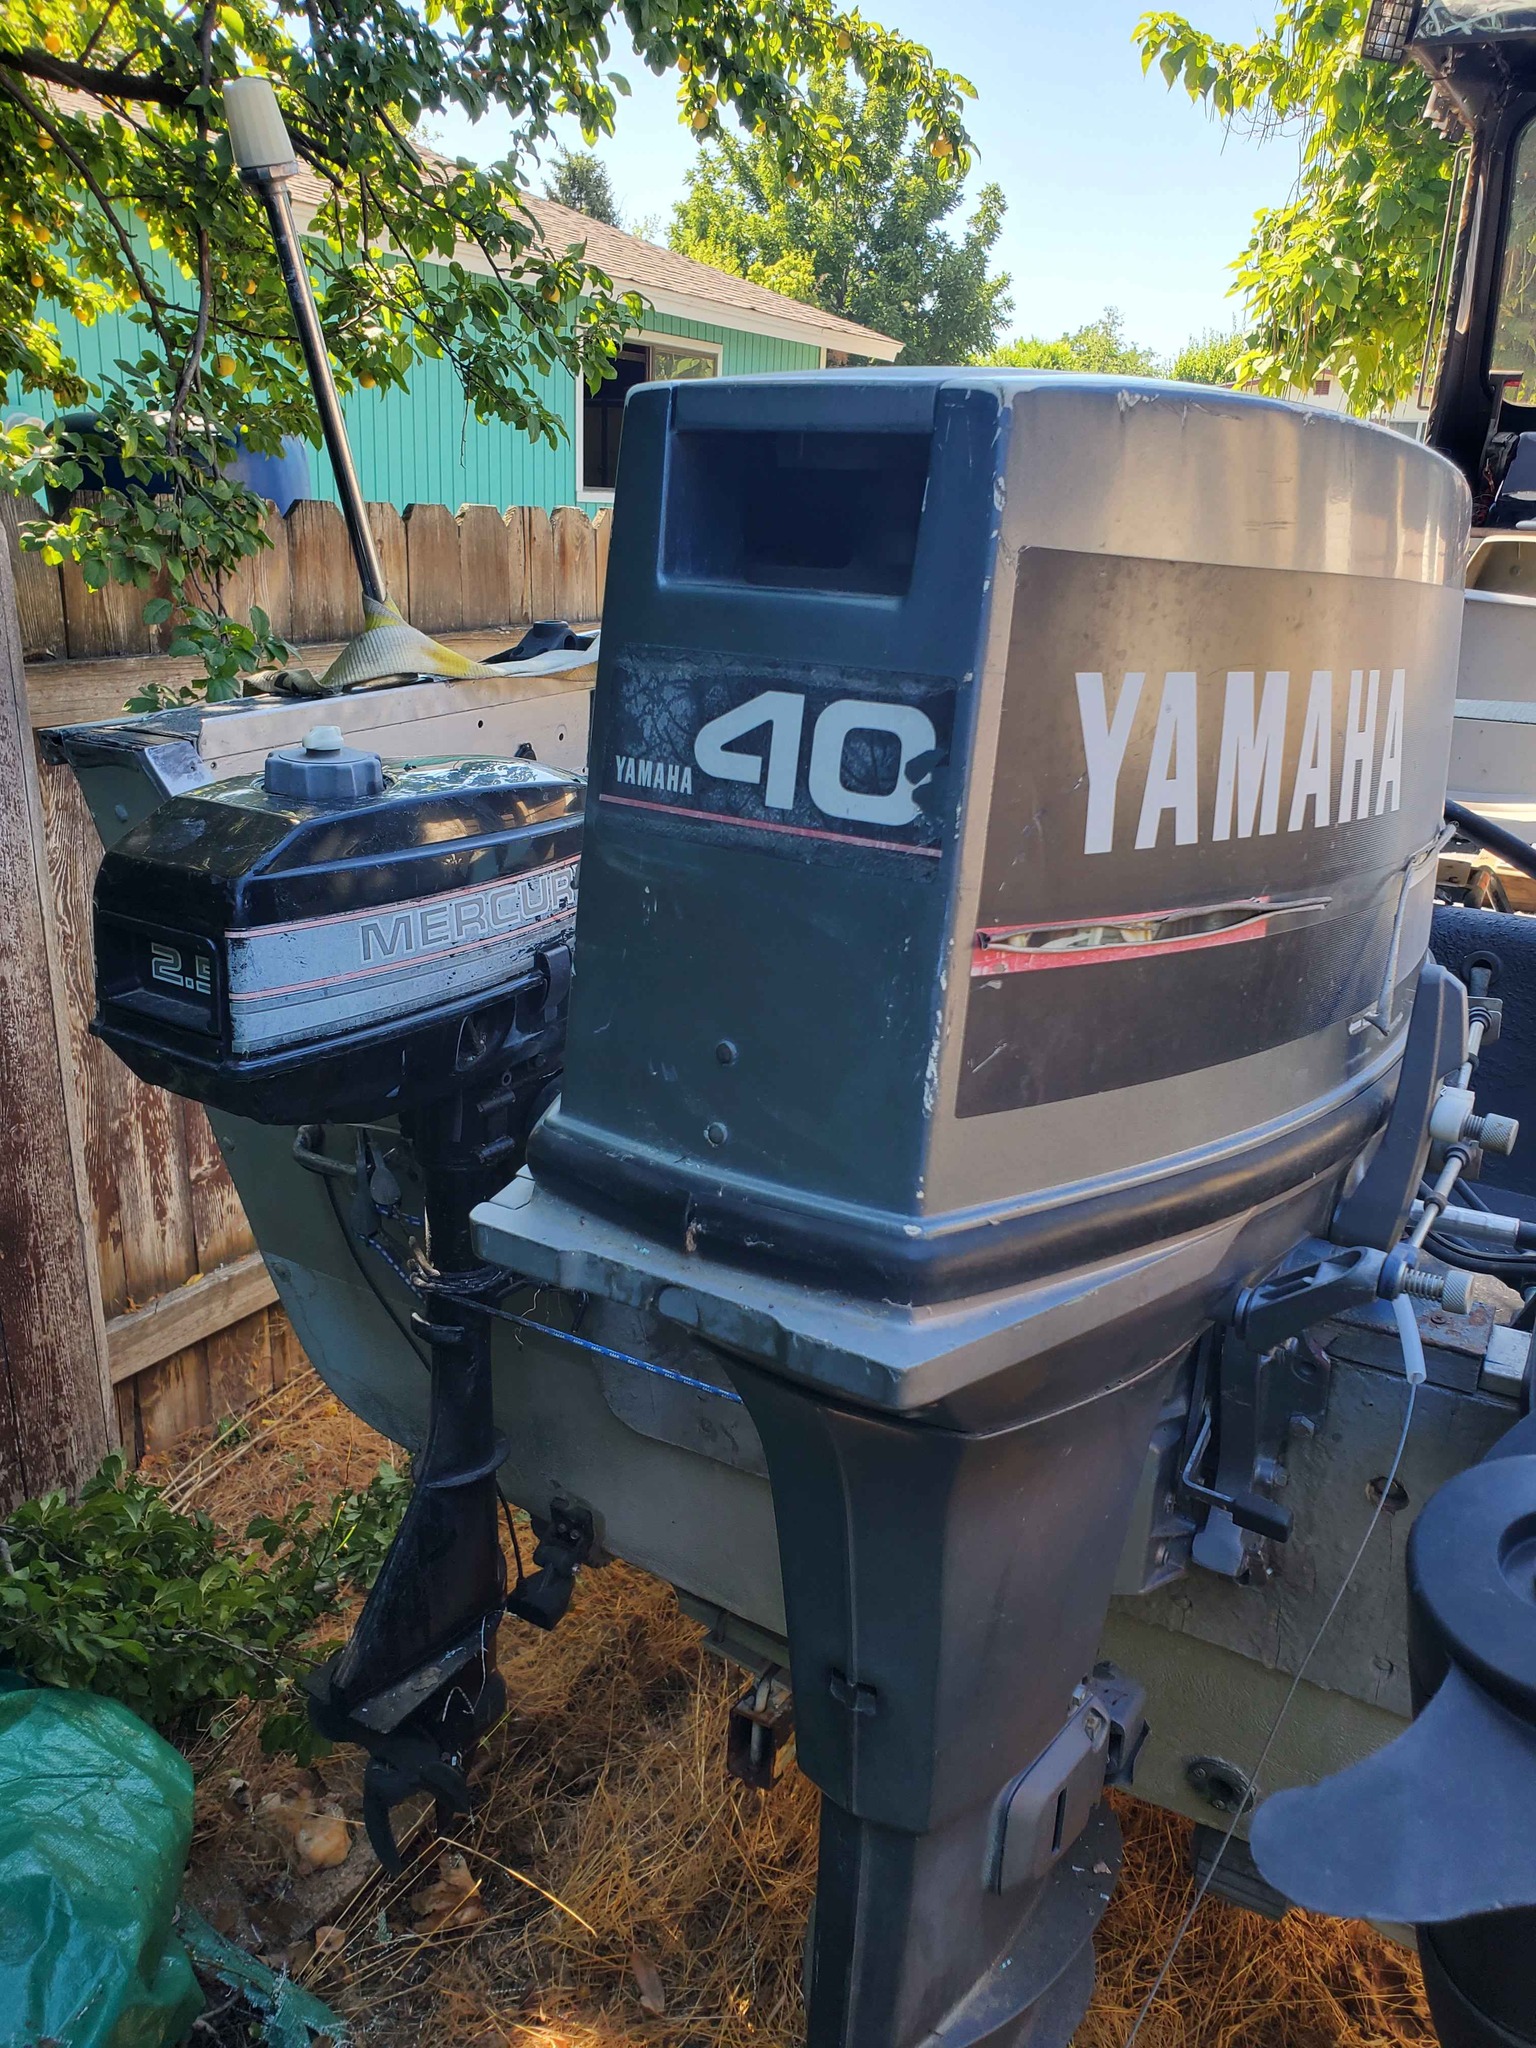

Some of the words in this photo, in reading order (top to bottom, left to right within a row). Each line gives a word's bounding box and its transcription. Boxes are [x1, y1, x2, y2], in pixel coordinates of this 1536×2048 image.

[615, 754, 693, 795] YAMAHA
[694, 690, 937, 826] 40
[1075, 669, 1406, 854] YAMAHA
[360, 866, 577, 963] MERCUR
